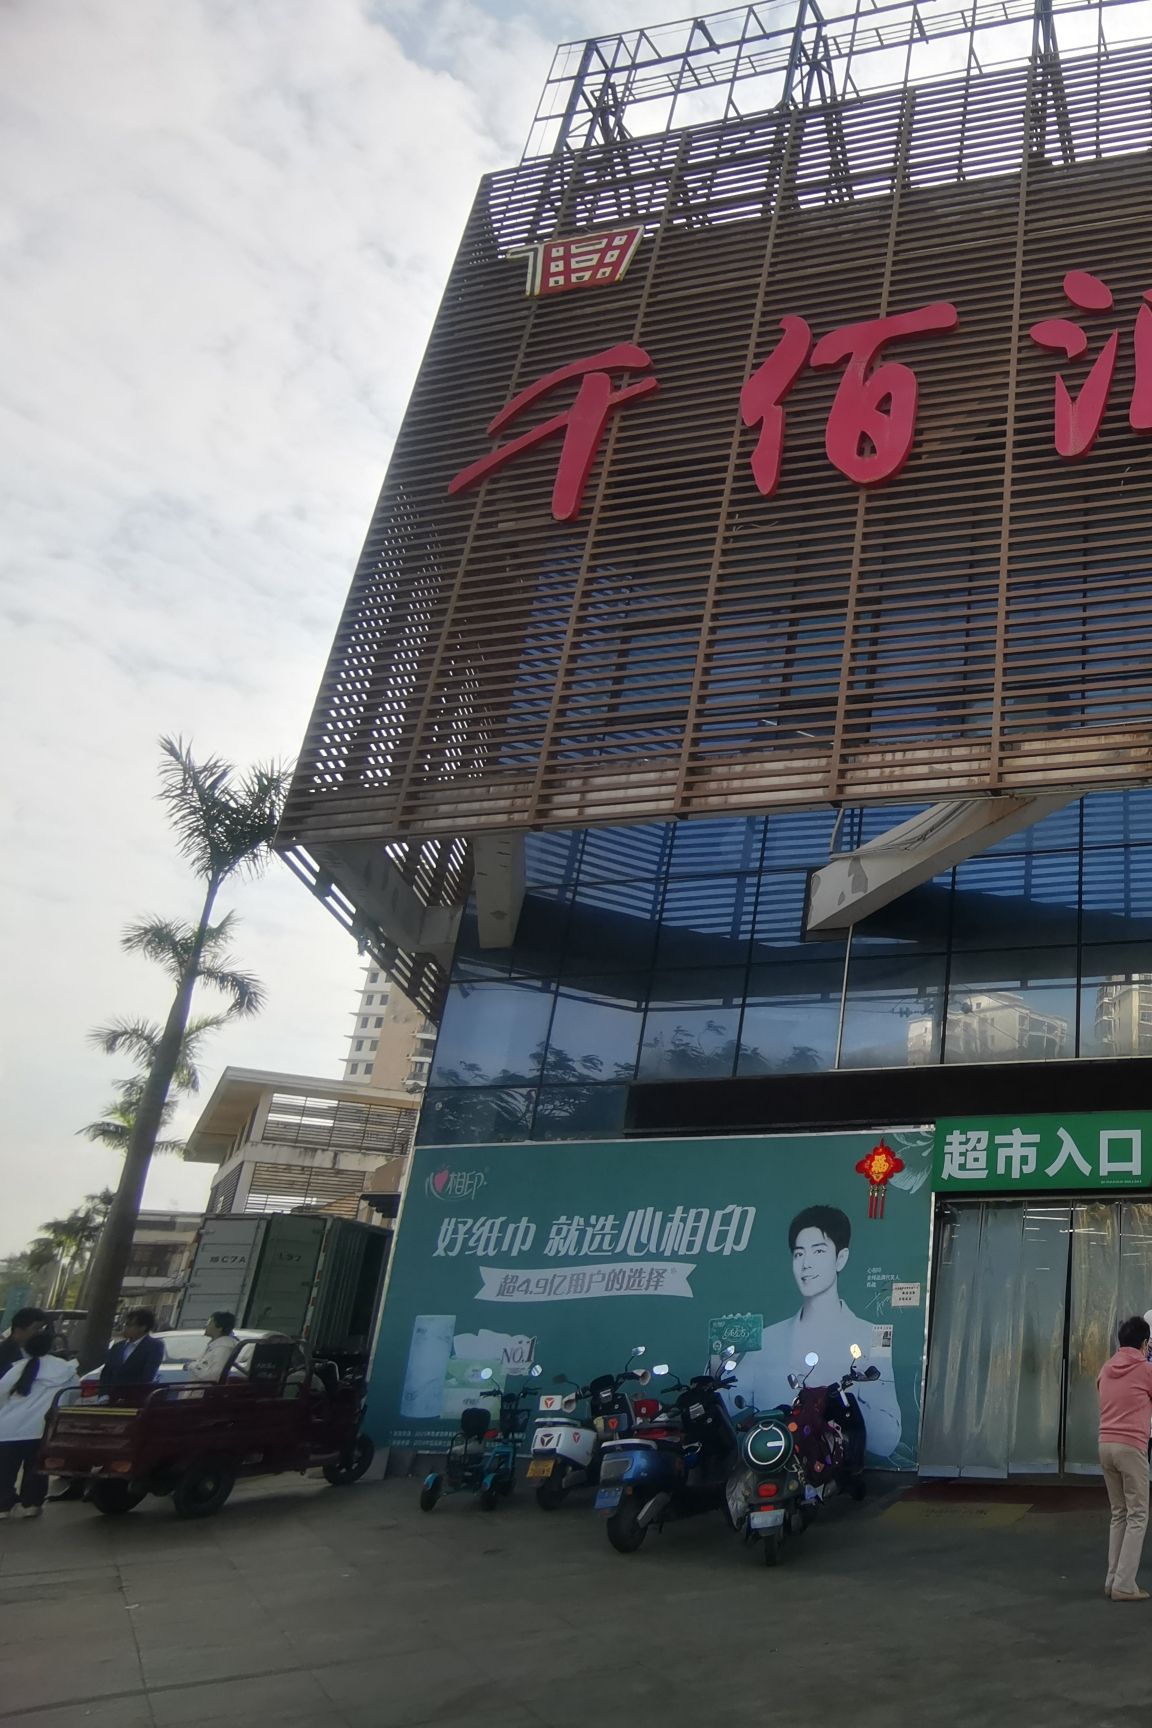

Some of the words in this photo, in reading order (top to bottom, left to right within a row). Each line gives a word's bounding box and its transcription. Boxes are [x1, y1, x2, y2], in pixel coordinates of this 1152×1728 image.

[941, 1127, 1141, 1180] 超市入口
[432, 1216, 536, 1257] 好纸巾
[544, 1204, 756, 1257] 就选心相印
[496, 1267, 668, 1299] 超4.9亿用户的选择
